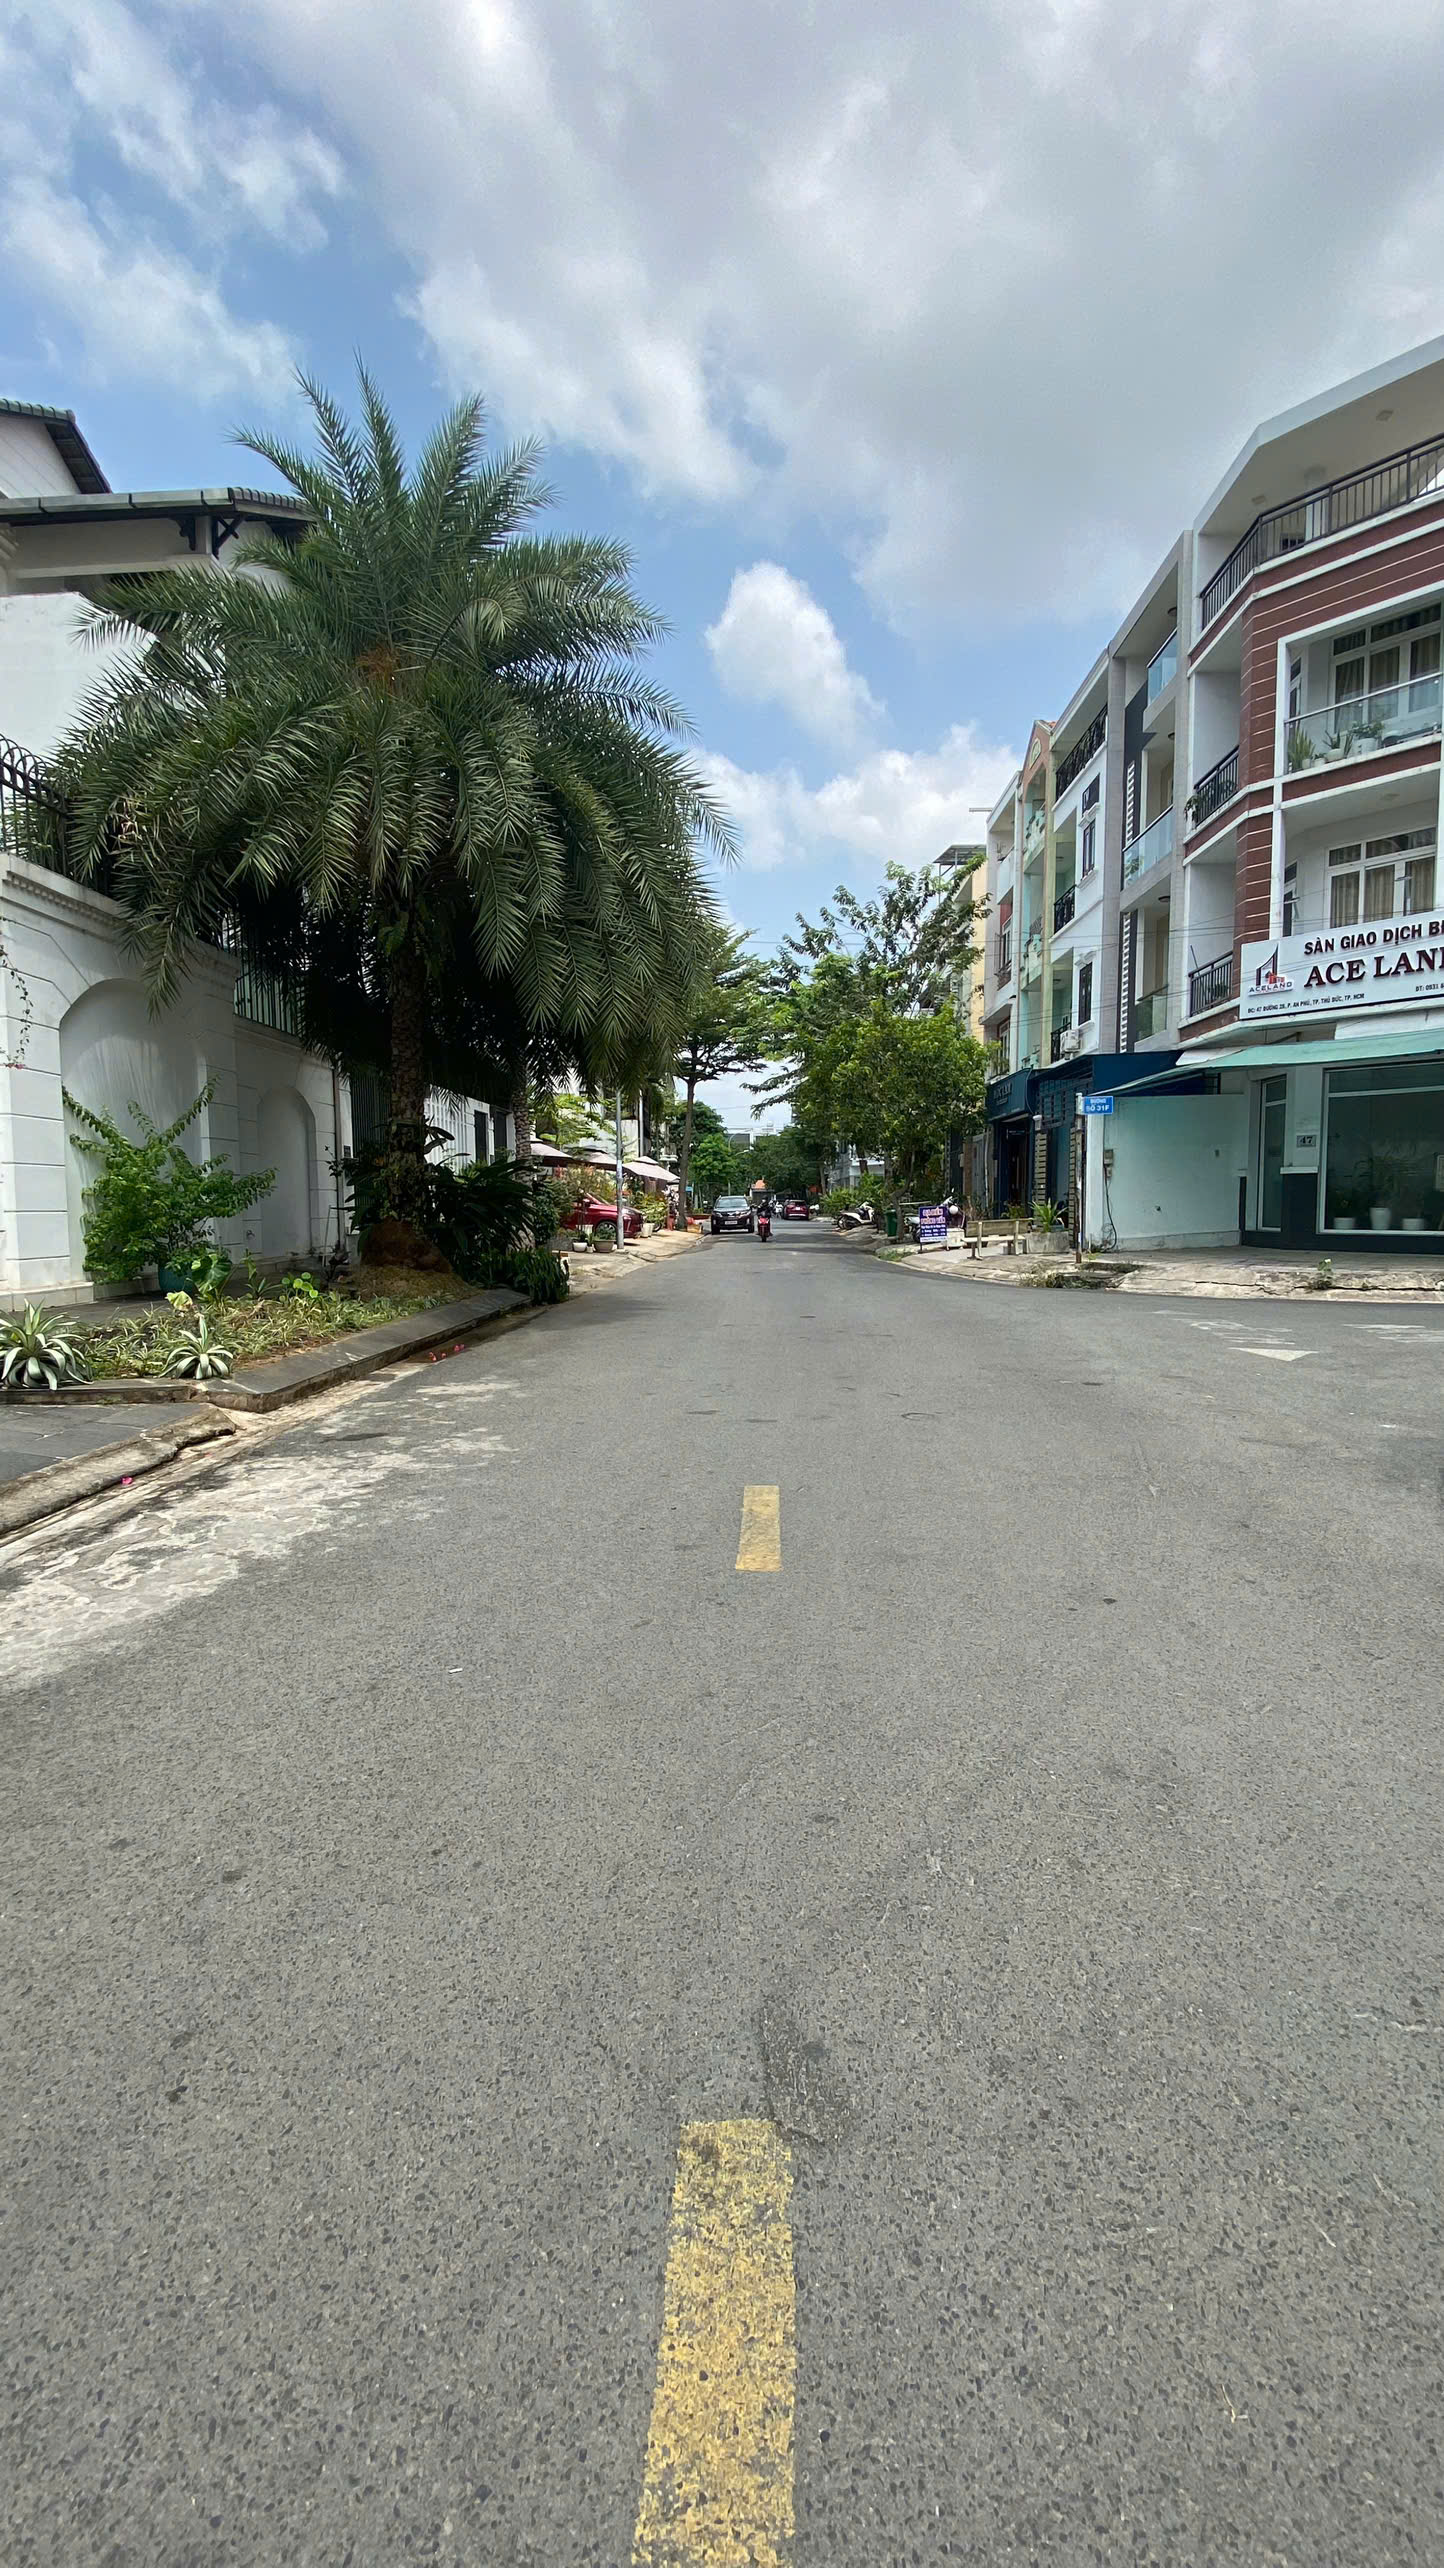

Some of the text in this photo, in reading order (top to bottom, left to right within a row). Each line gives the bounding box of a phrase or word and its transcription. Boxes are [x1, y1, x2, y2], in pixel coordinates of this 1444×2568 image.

[1304, 920, 1444, 955] SÀN GIAO DỊCH B
[1304, 947, 1444, 987] ACE LAN
[1249, 981, 1293, 993] ACELAND
[1300, 1136, 1313, 1144] 47
